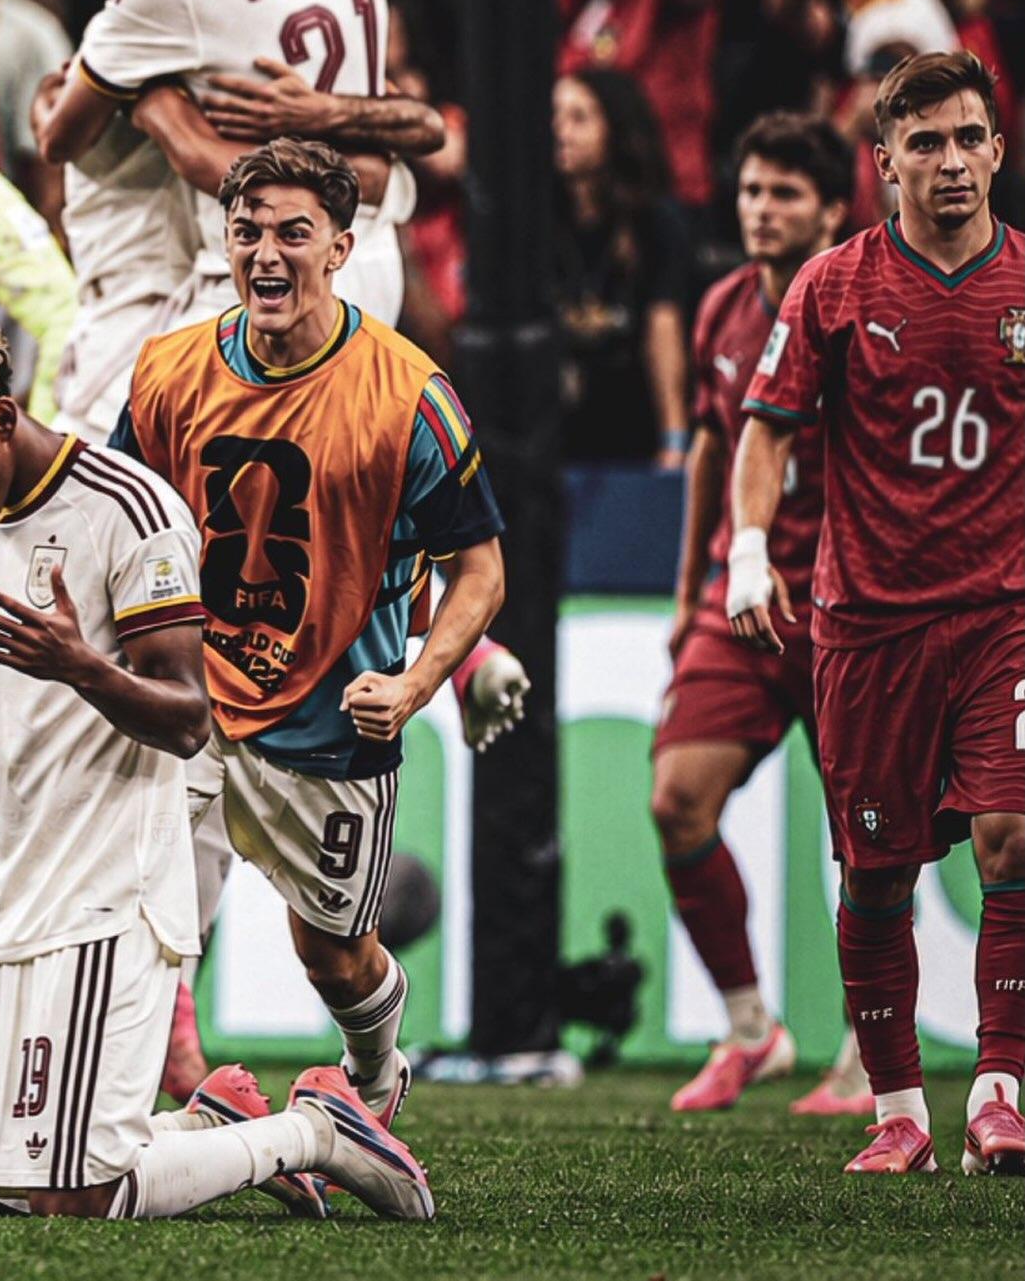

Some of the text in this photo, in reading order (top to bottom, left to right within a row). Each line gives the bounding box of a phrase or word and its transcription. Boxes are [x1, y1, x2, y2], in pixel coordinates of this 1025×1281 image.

[910, 385, 989, 472] 26
[235, 587, 288, 612] FIFA
[317, 810, 364, 880] 9
[12, 1035, 53, 1118] 19
